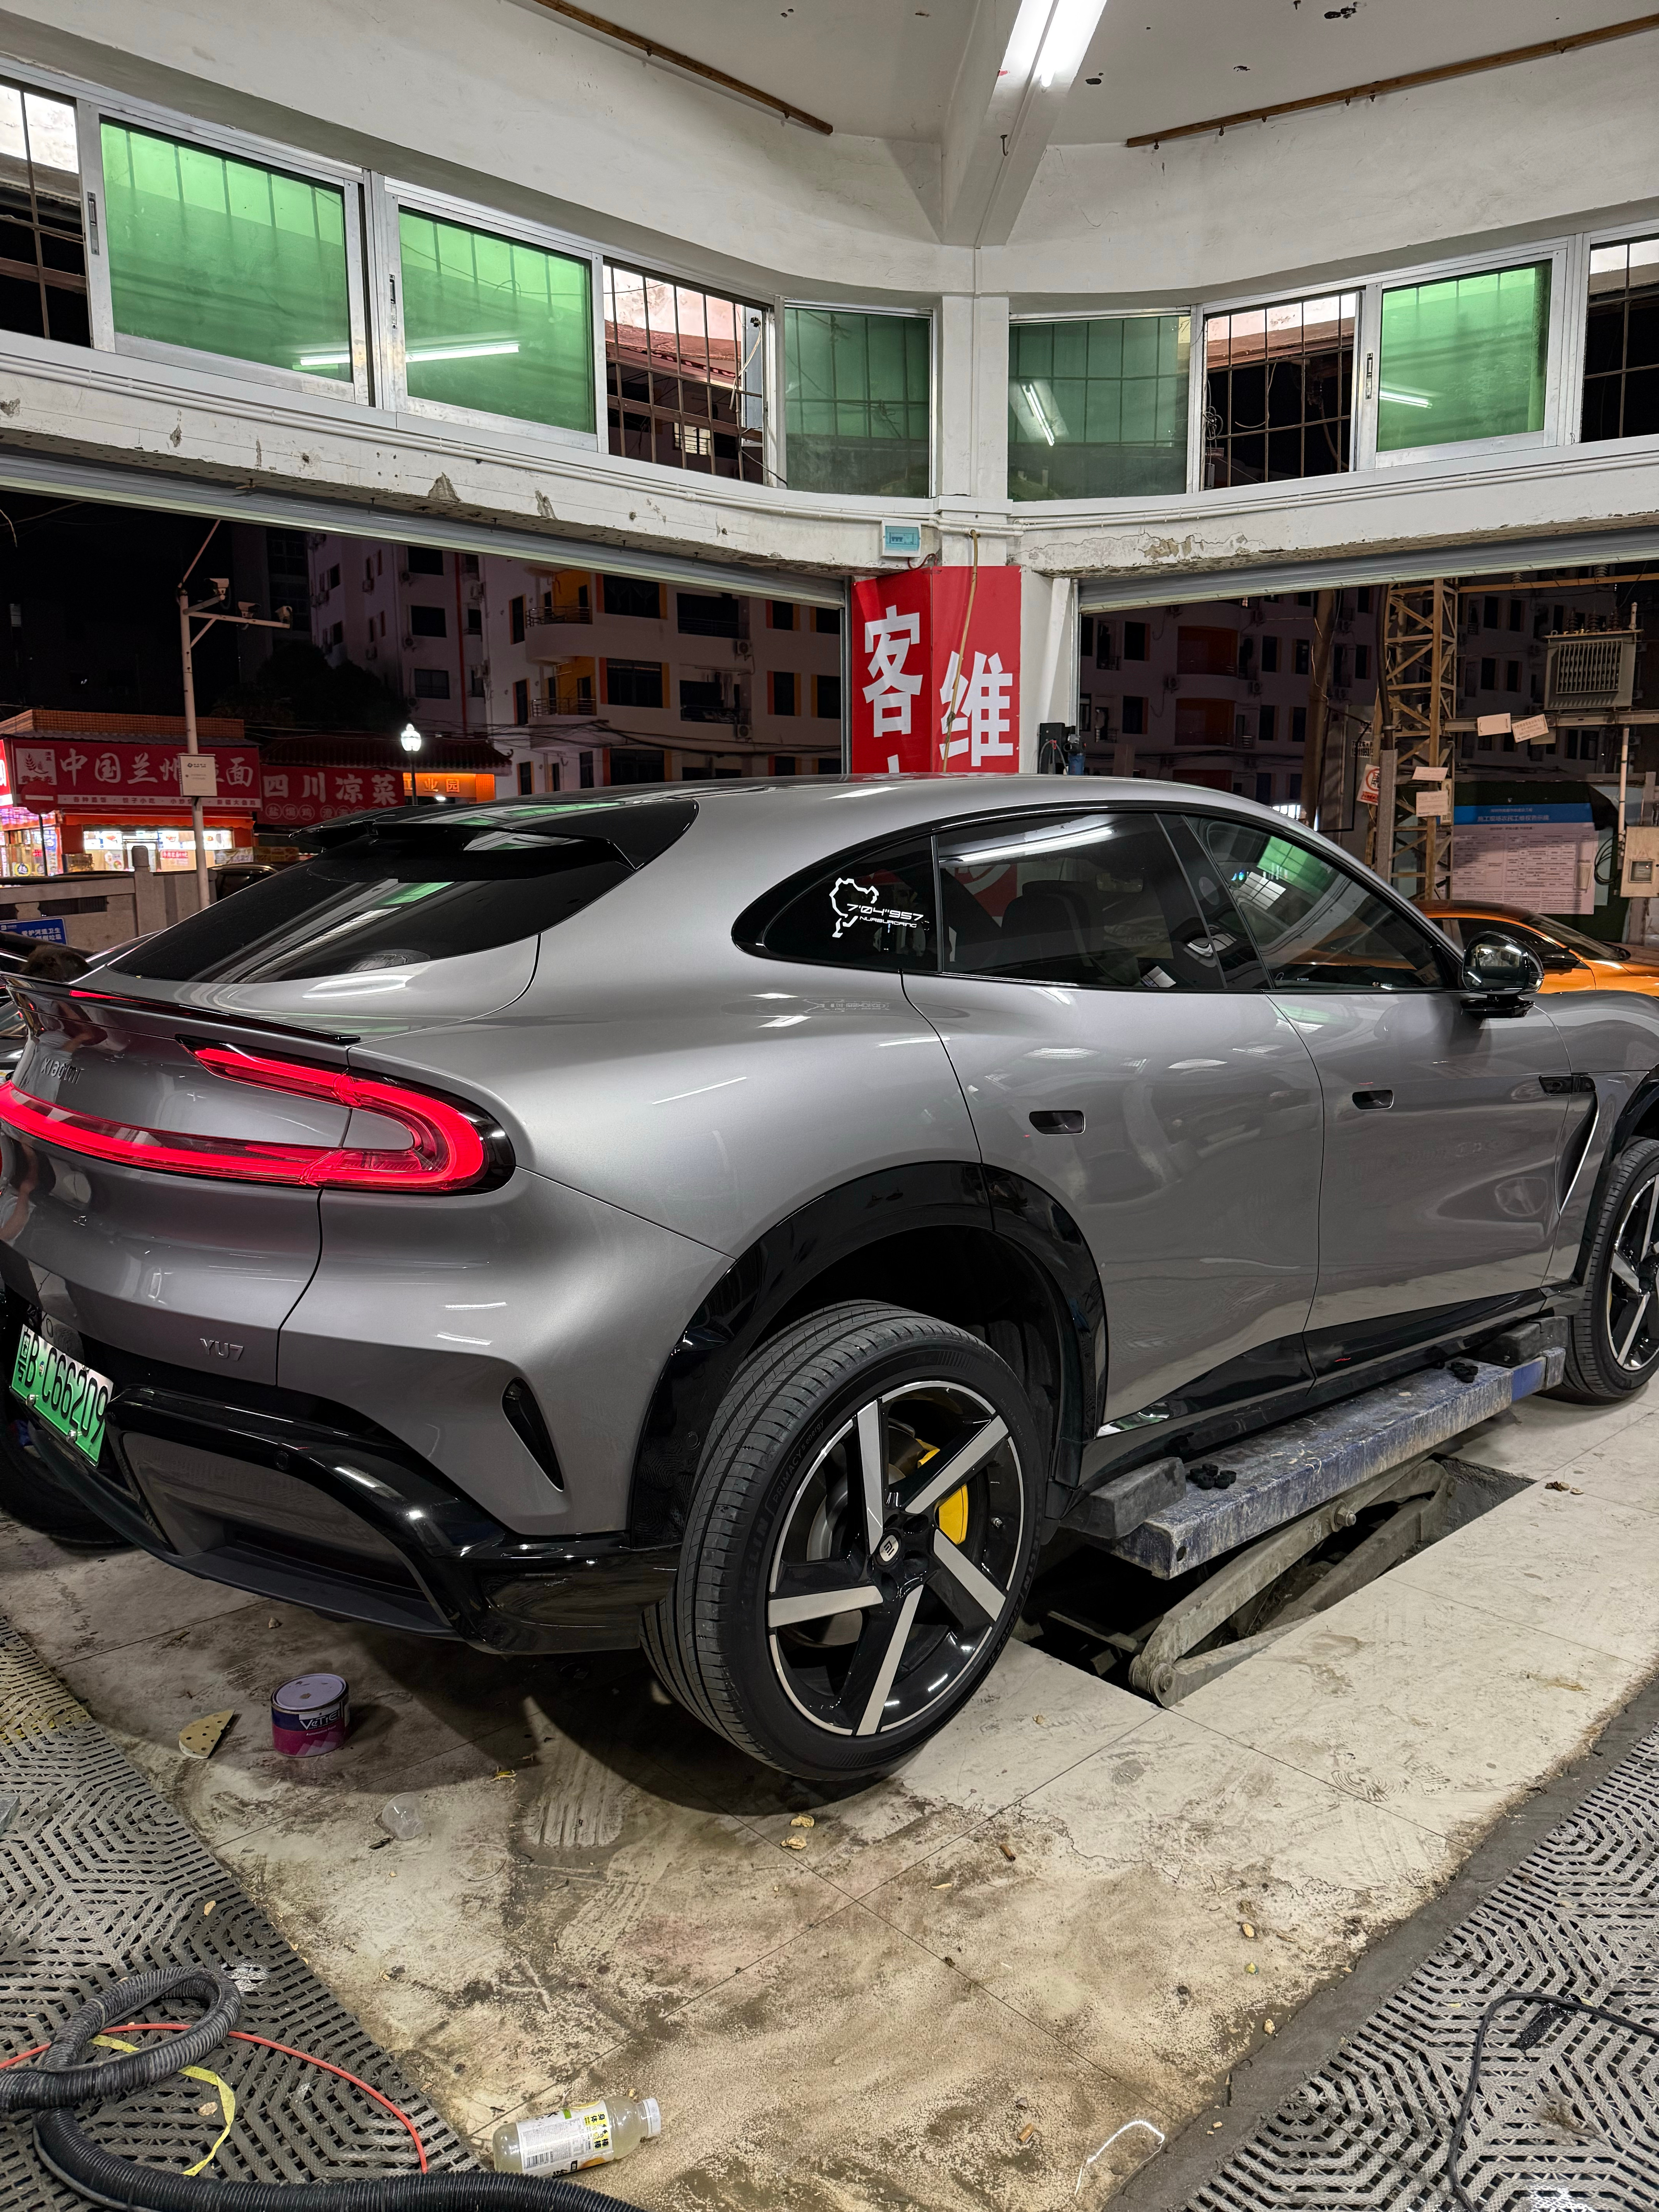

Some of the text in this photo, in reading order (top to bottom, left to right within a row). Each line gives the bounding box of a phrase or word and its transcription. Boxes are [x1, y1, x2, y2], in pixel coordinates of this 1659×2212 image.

[863, 605, 923, 773] 客
[940, 651, 1013, 767] 维
[60, 748, 254, 788] 中国兰州面
[263, 772, 398, 805] 四川凉菜
[199, 1338, 244, 1361] YU7
[773, 1449, 802, 1503] PRIMACY
[805, 1419, 824, 1444] energy
